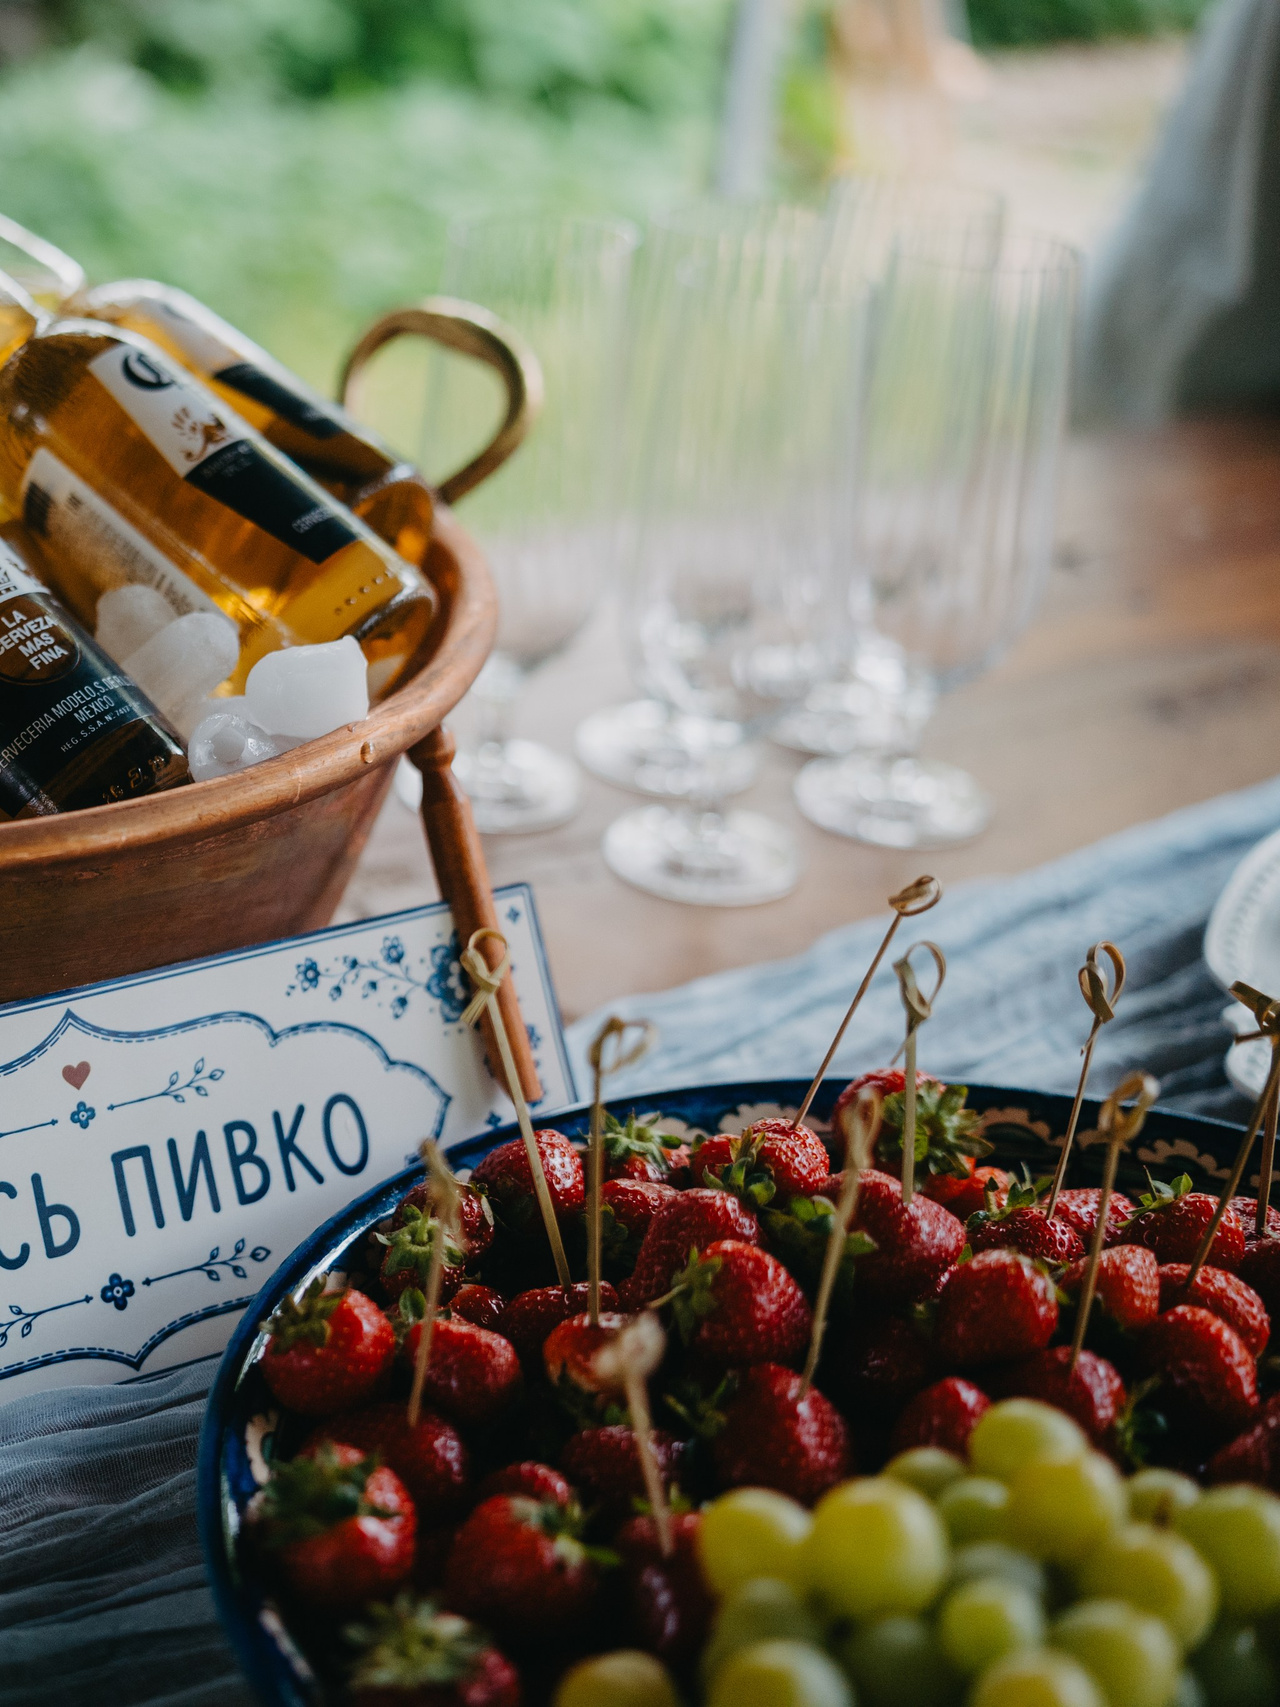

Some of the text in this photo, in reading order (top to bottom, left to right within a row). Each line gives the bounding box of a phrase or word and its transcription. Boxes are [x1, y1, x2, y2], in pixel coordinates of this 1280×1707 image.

[1, 610, 27, 628] LA
[18, 632, 55, 657] MAS
[29, 645, 69, 670] FINA
[73, 695, 115, 724] MEXICO
[111, 1093, 370, 1237] ПИВКО
